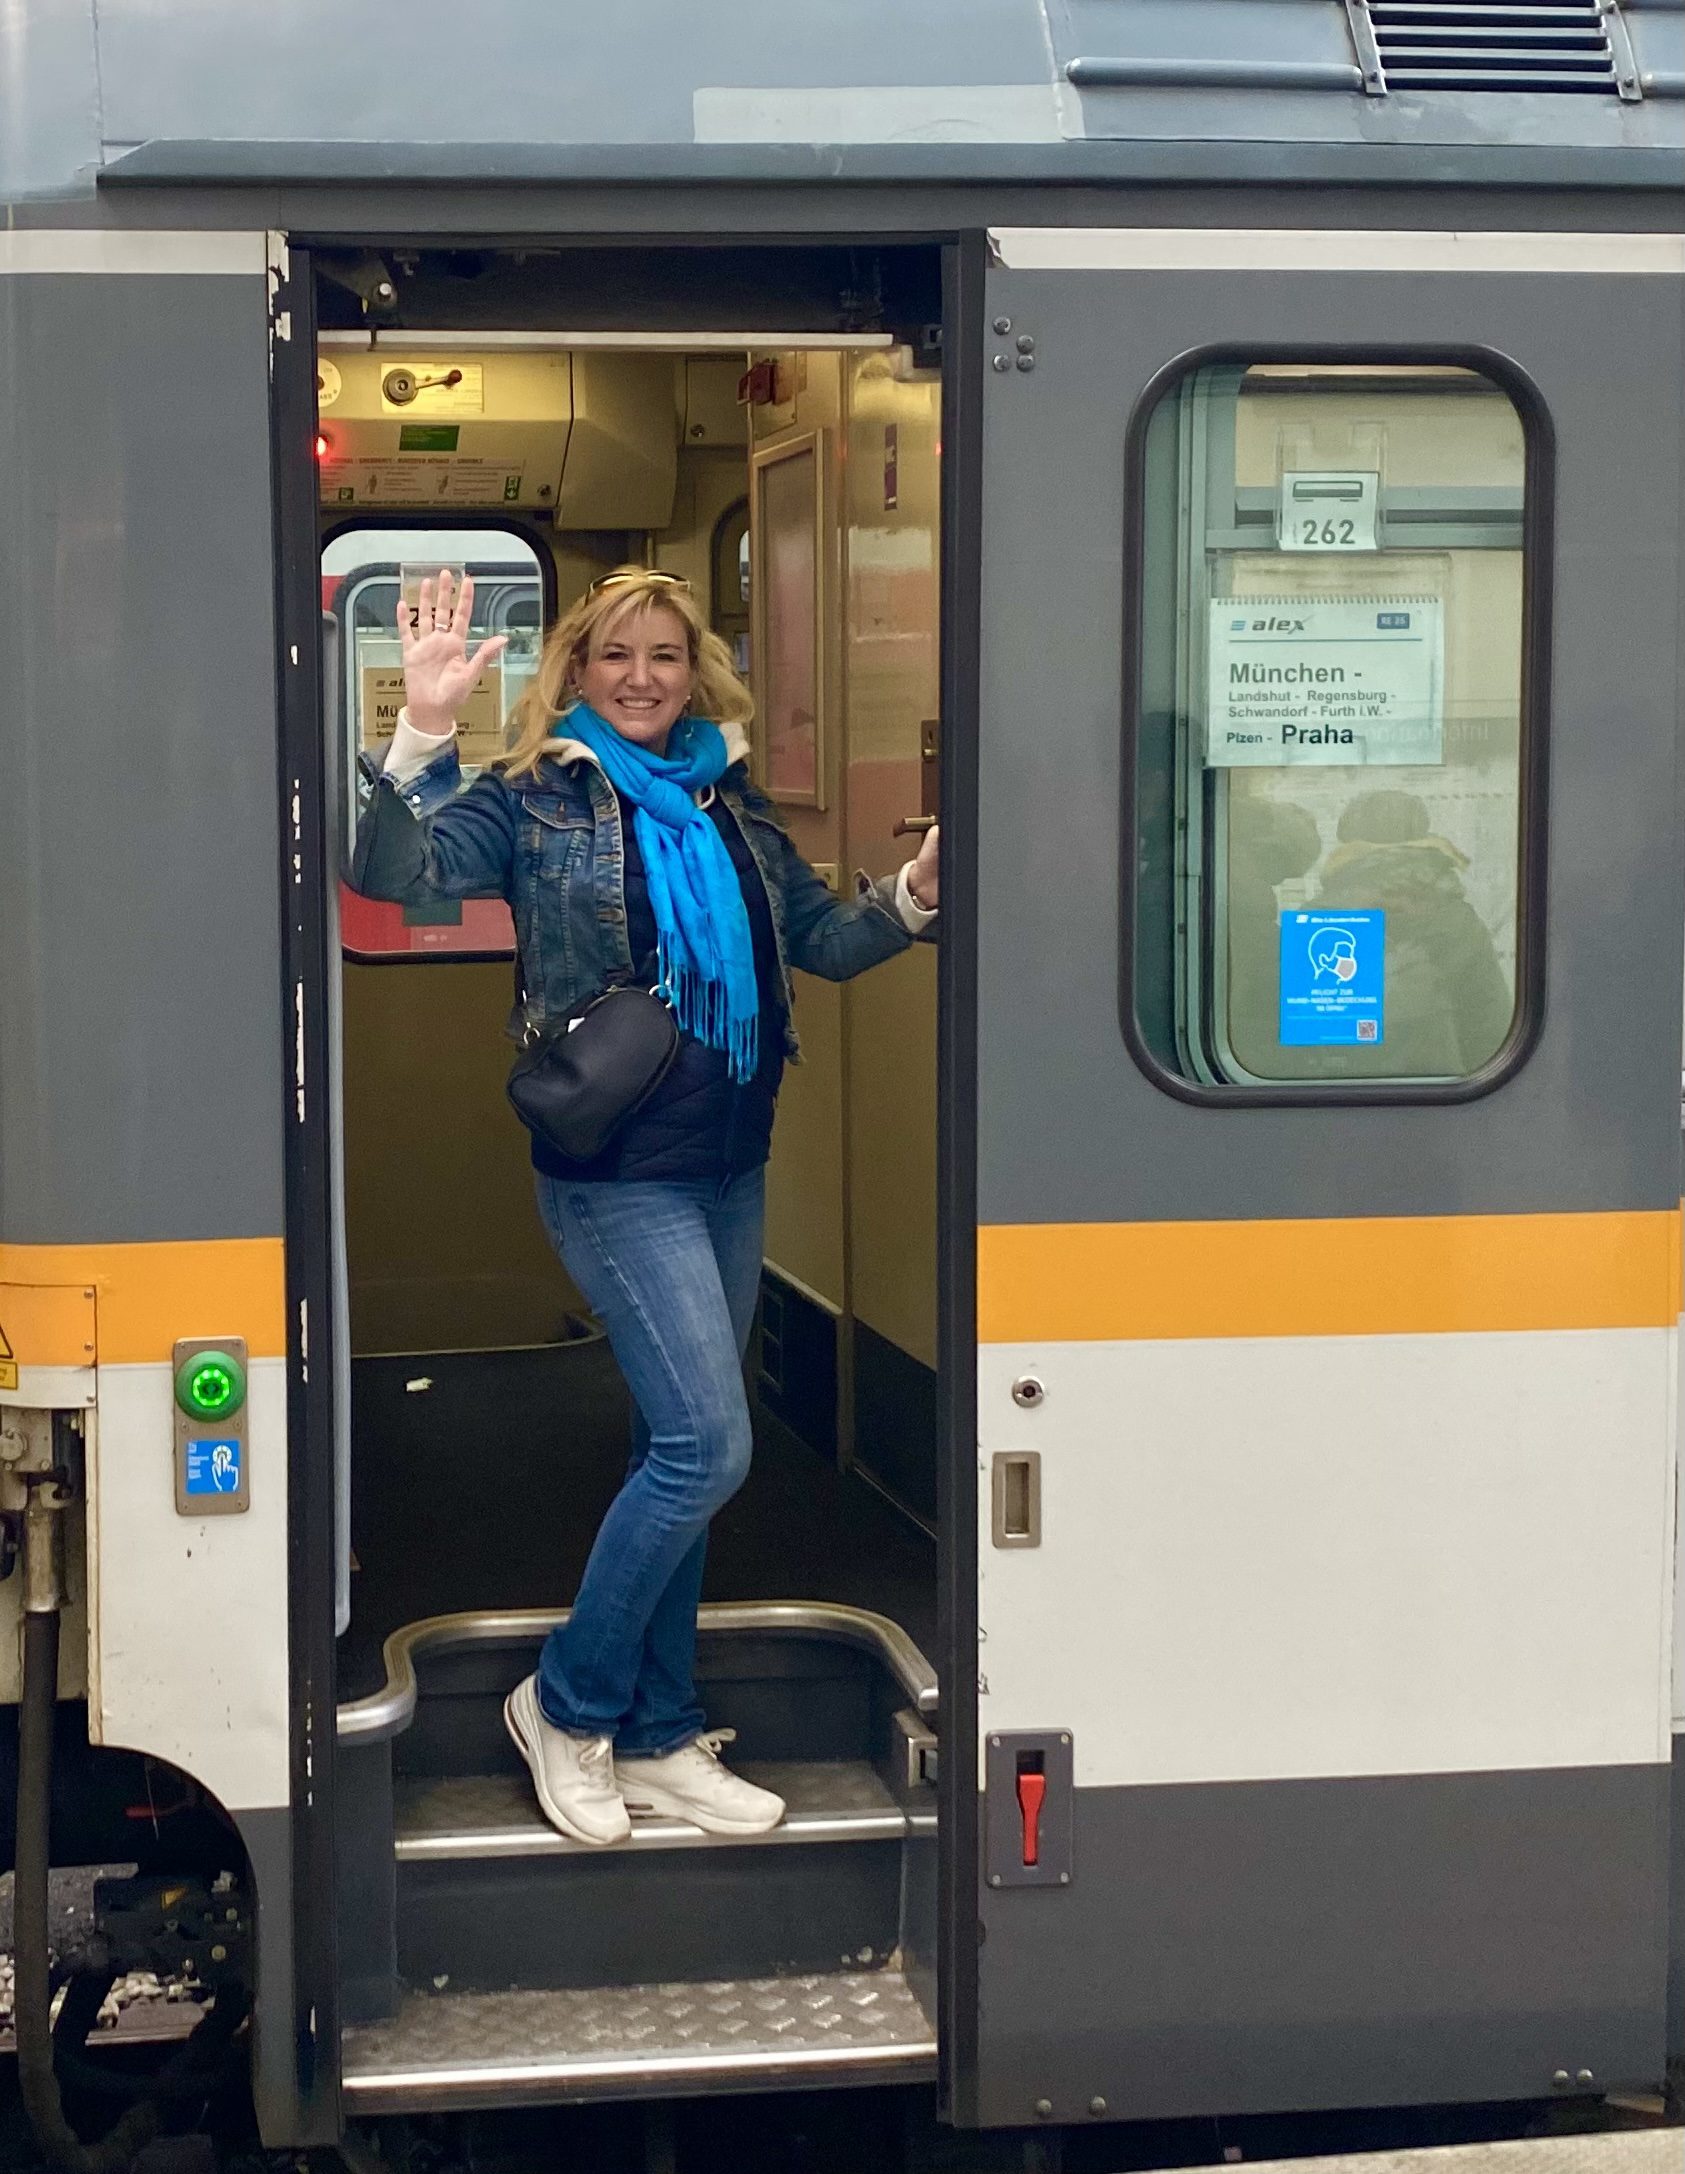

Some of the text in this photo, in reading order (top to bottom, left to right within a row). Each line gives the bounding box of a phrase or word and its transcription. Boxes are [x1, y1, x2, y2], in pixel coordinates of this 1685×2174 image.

[1303, 519, 1356, 545] 262
[1252, 616, 1309, 635] alex
[1229, 662, 1345, 684] München
[1228, 690, 1292, 703] Landshut
[1306, 689, 1387, 706] Regensburg
[1228, 705, 1309, 719] Schwandorf
[1320, 704, 1356, 717] Furth
[1226, 731, 1264, 744] Plzen
[1281, 723, 1354, 745] Praha
